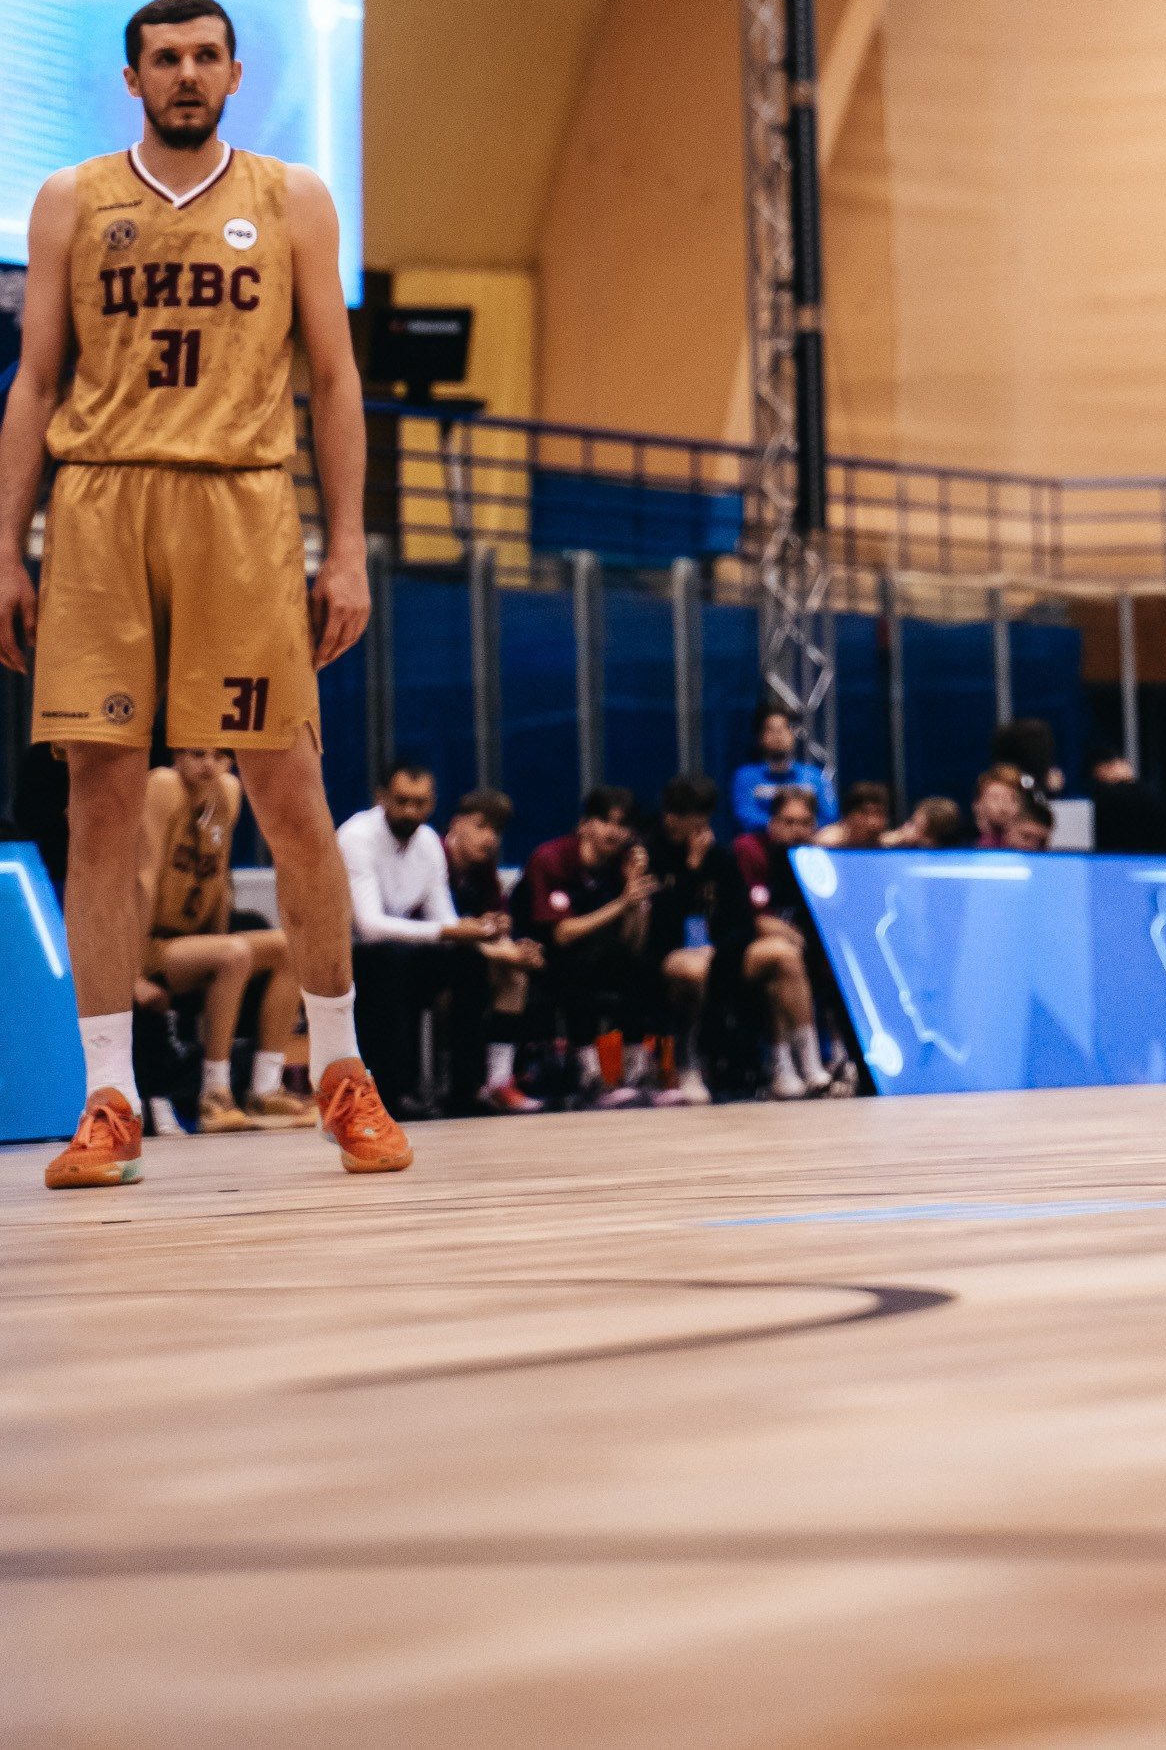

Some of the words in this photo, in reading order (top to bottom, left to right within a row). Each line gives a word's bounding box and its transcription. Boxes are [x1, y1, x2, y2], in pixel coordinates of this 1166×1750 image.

[100, 261, 262, 318] ЦИВС
[147, 328, 202, 389] 31
[221, 677, 270, 731] 31
